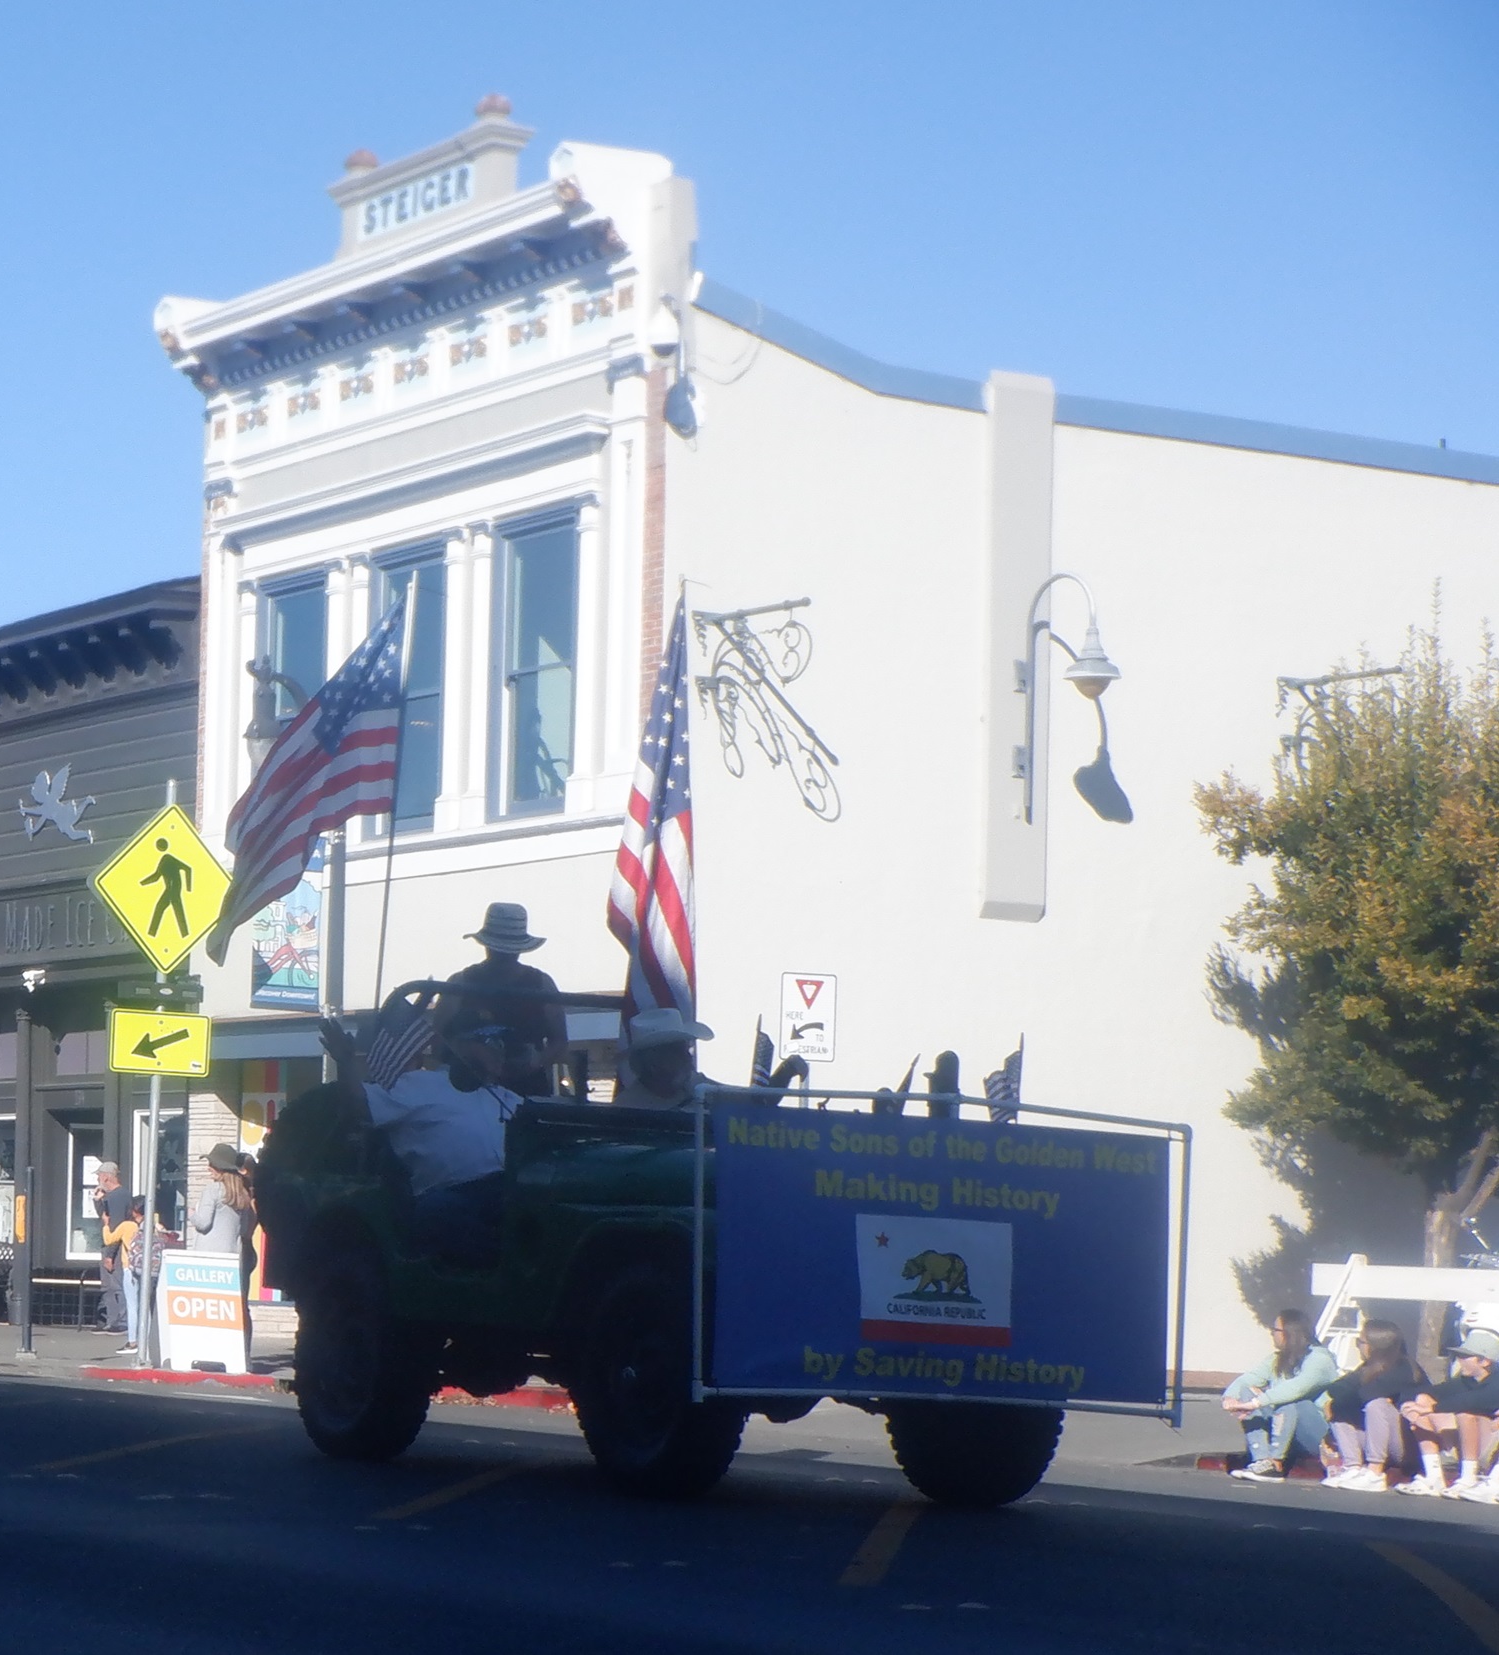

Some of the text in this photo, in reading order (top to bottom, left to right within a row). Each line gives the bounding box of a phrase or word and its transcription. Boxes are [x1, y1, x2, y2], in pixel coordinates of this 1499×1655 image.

[364, 168, 468, 234] STEIGER
[5, 901, 55, 954] MADE
[65, 895, 96, 947] ICE
[785, 1010, 804, 1021] HERE
[815, 1033, 825, 1043] TO
[727, 1116, 1157, 1175] Native Sons of the Golden West
[814, 1169, 1060, 1220] Making History
[175, 1267, 235, 1285] GALLERY
[172, 1295, 236, 1322] OPEN
[886, 1302, 987, 1320] CALIFORNIA REPUBLIC
[803, 1346, 1085, 1393] by Saving History
